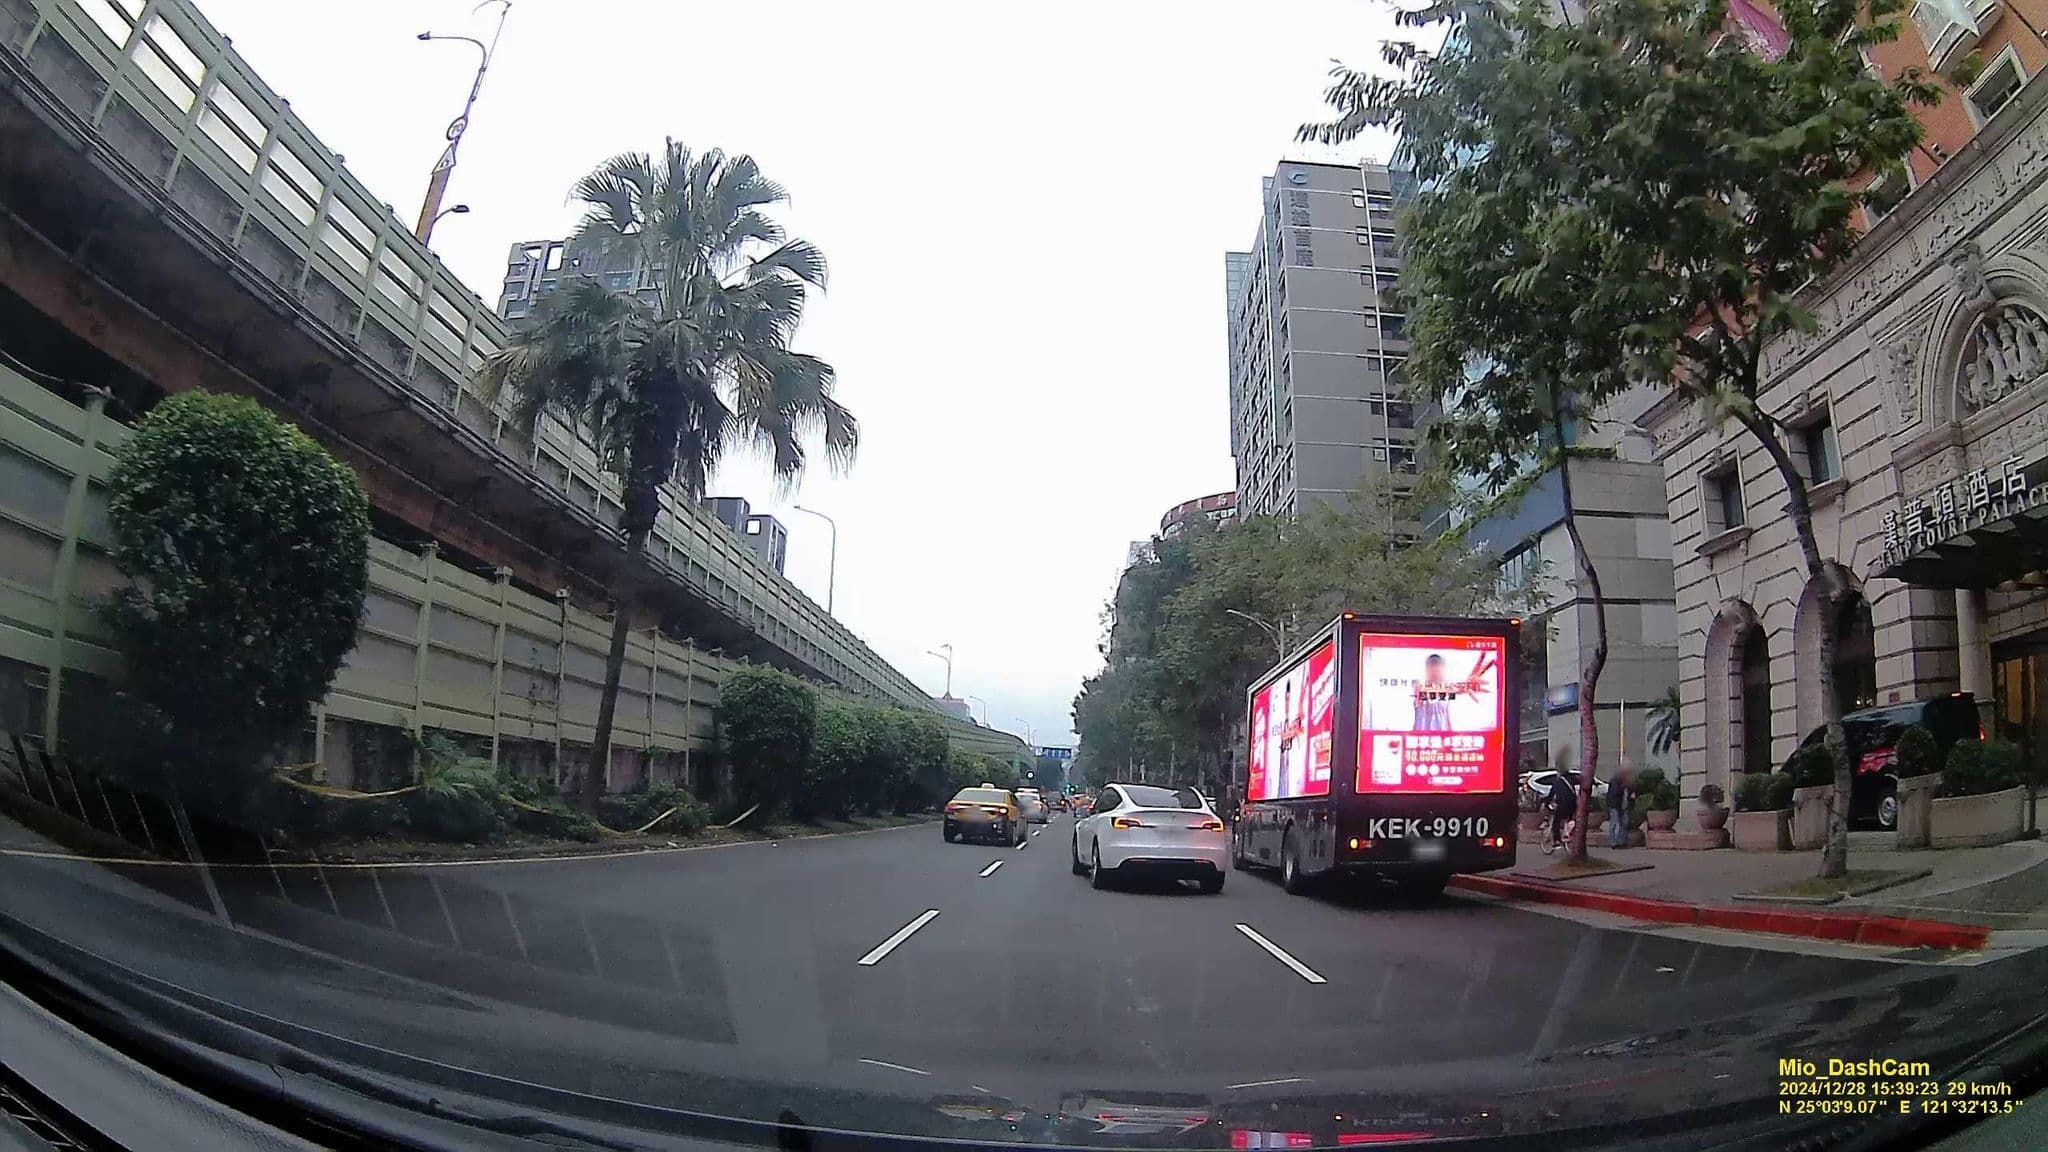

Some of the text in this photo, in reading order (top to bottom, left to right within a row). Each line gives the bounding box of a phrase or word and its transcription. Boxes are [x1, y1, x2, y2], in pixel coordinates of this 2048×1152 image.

[1881, 455, 2027, 549] 漢普頓酒店
[1918, 514, 1970, 549] COURT
[1369, 817, 1489, 840] KEK-9910
